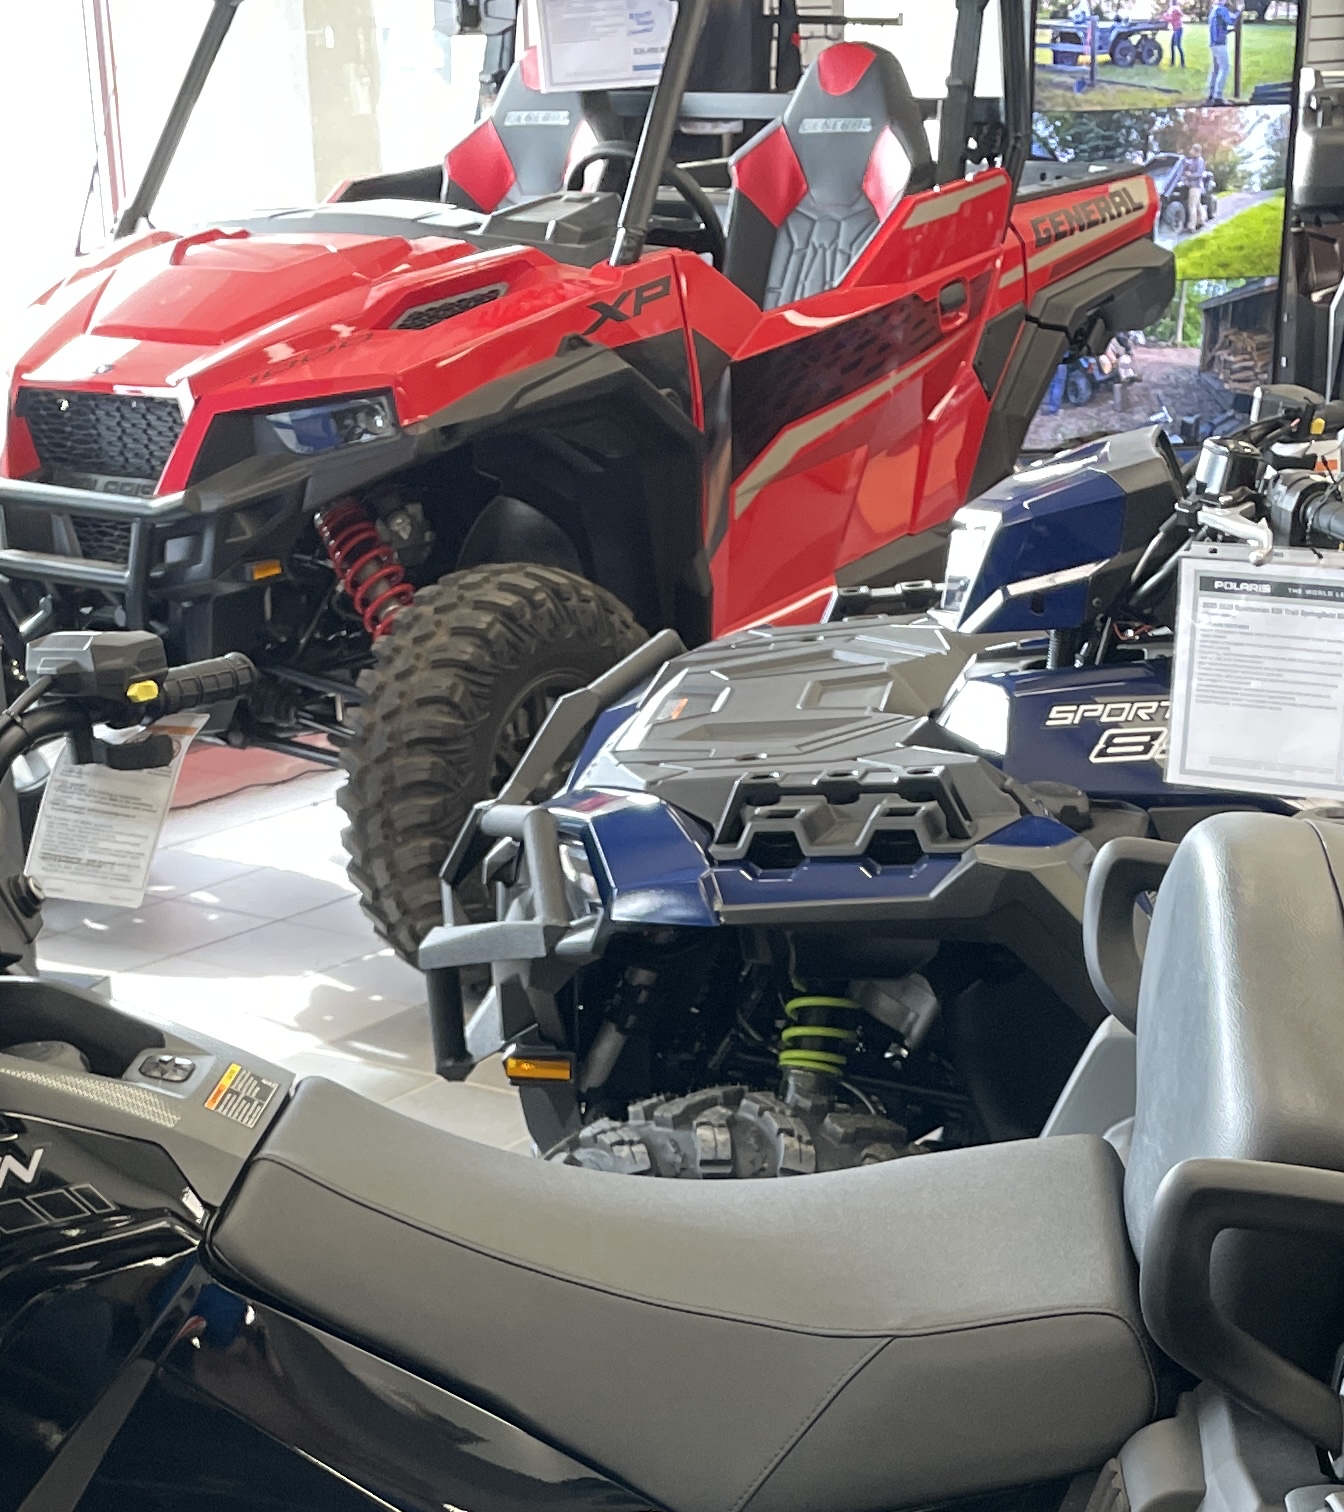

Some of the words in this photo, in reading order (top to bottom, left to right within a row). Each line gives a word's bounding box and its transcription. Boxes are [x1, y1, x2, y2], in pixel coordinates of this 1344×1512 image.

[1030, 186, 1144, 249] GENERAL
[582, 275, 672, 336] XP
[1213, 580, 1272, 594] POLARIS
[1045, 701, 1172, 727] SPORT
